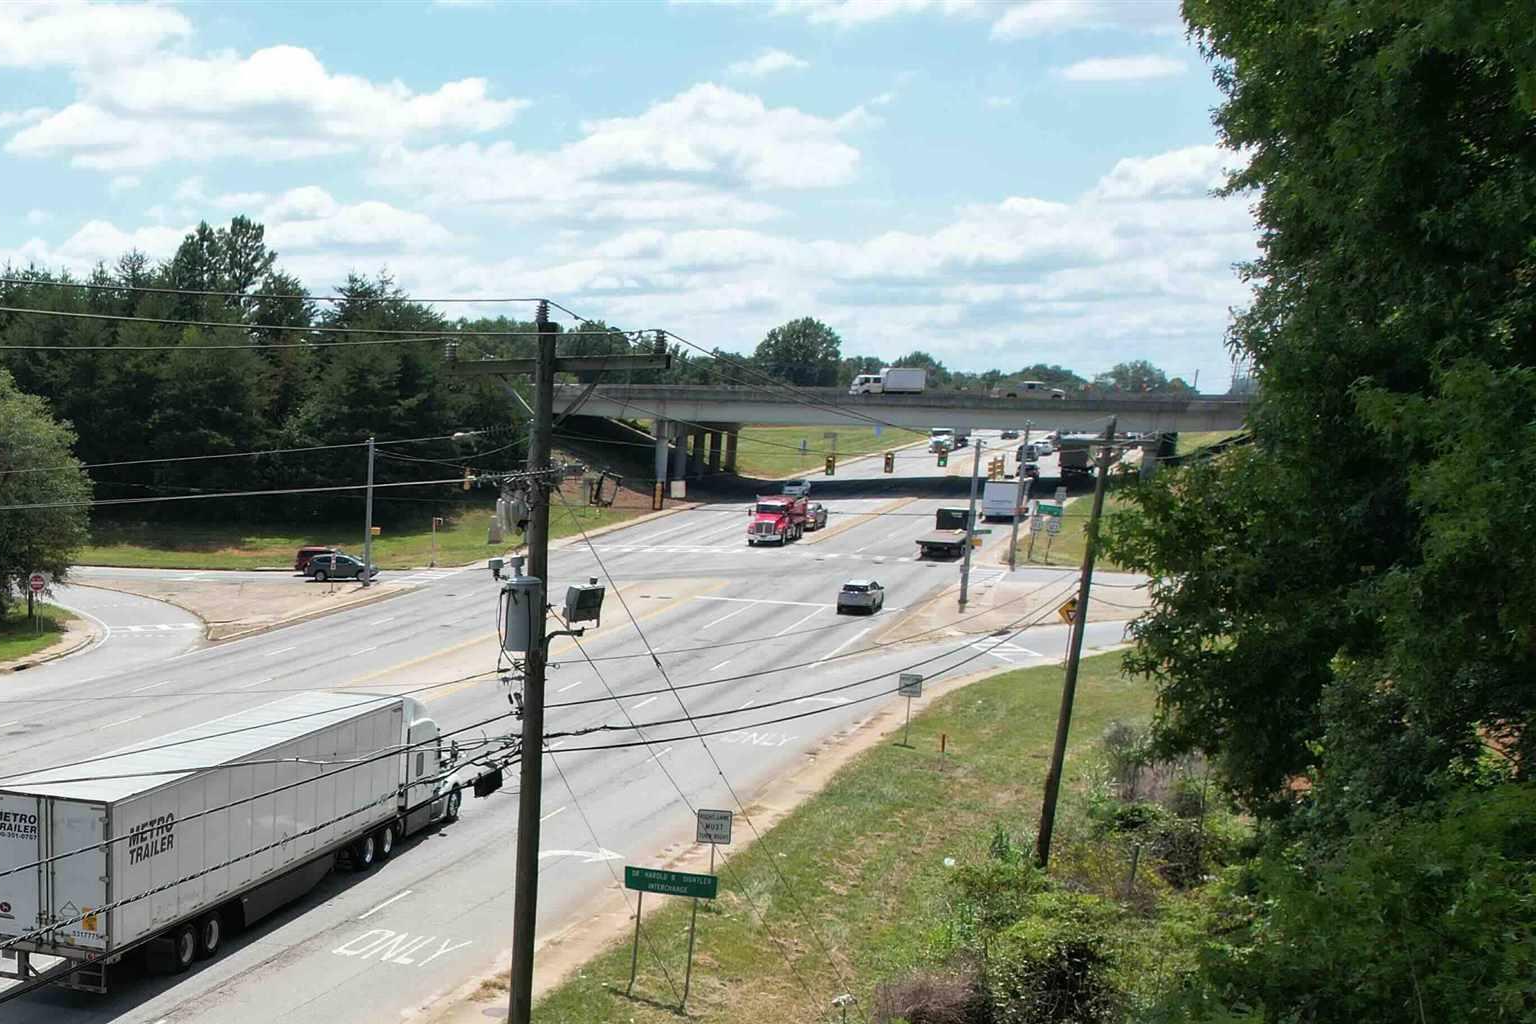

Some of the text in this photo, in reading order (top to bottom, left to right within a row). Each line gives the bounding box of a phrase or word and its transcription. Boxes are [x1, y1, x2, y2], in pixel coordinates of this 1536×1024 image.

[128, 812, 174, 848] METRO
[128, 833, 174, 865] TRAILER
[332, 929, 473, 968] ONLY
